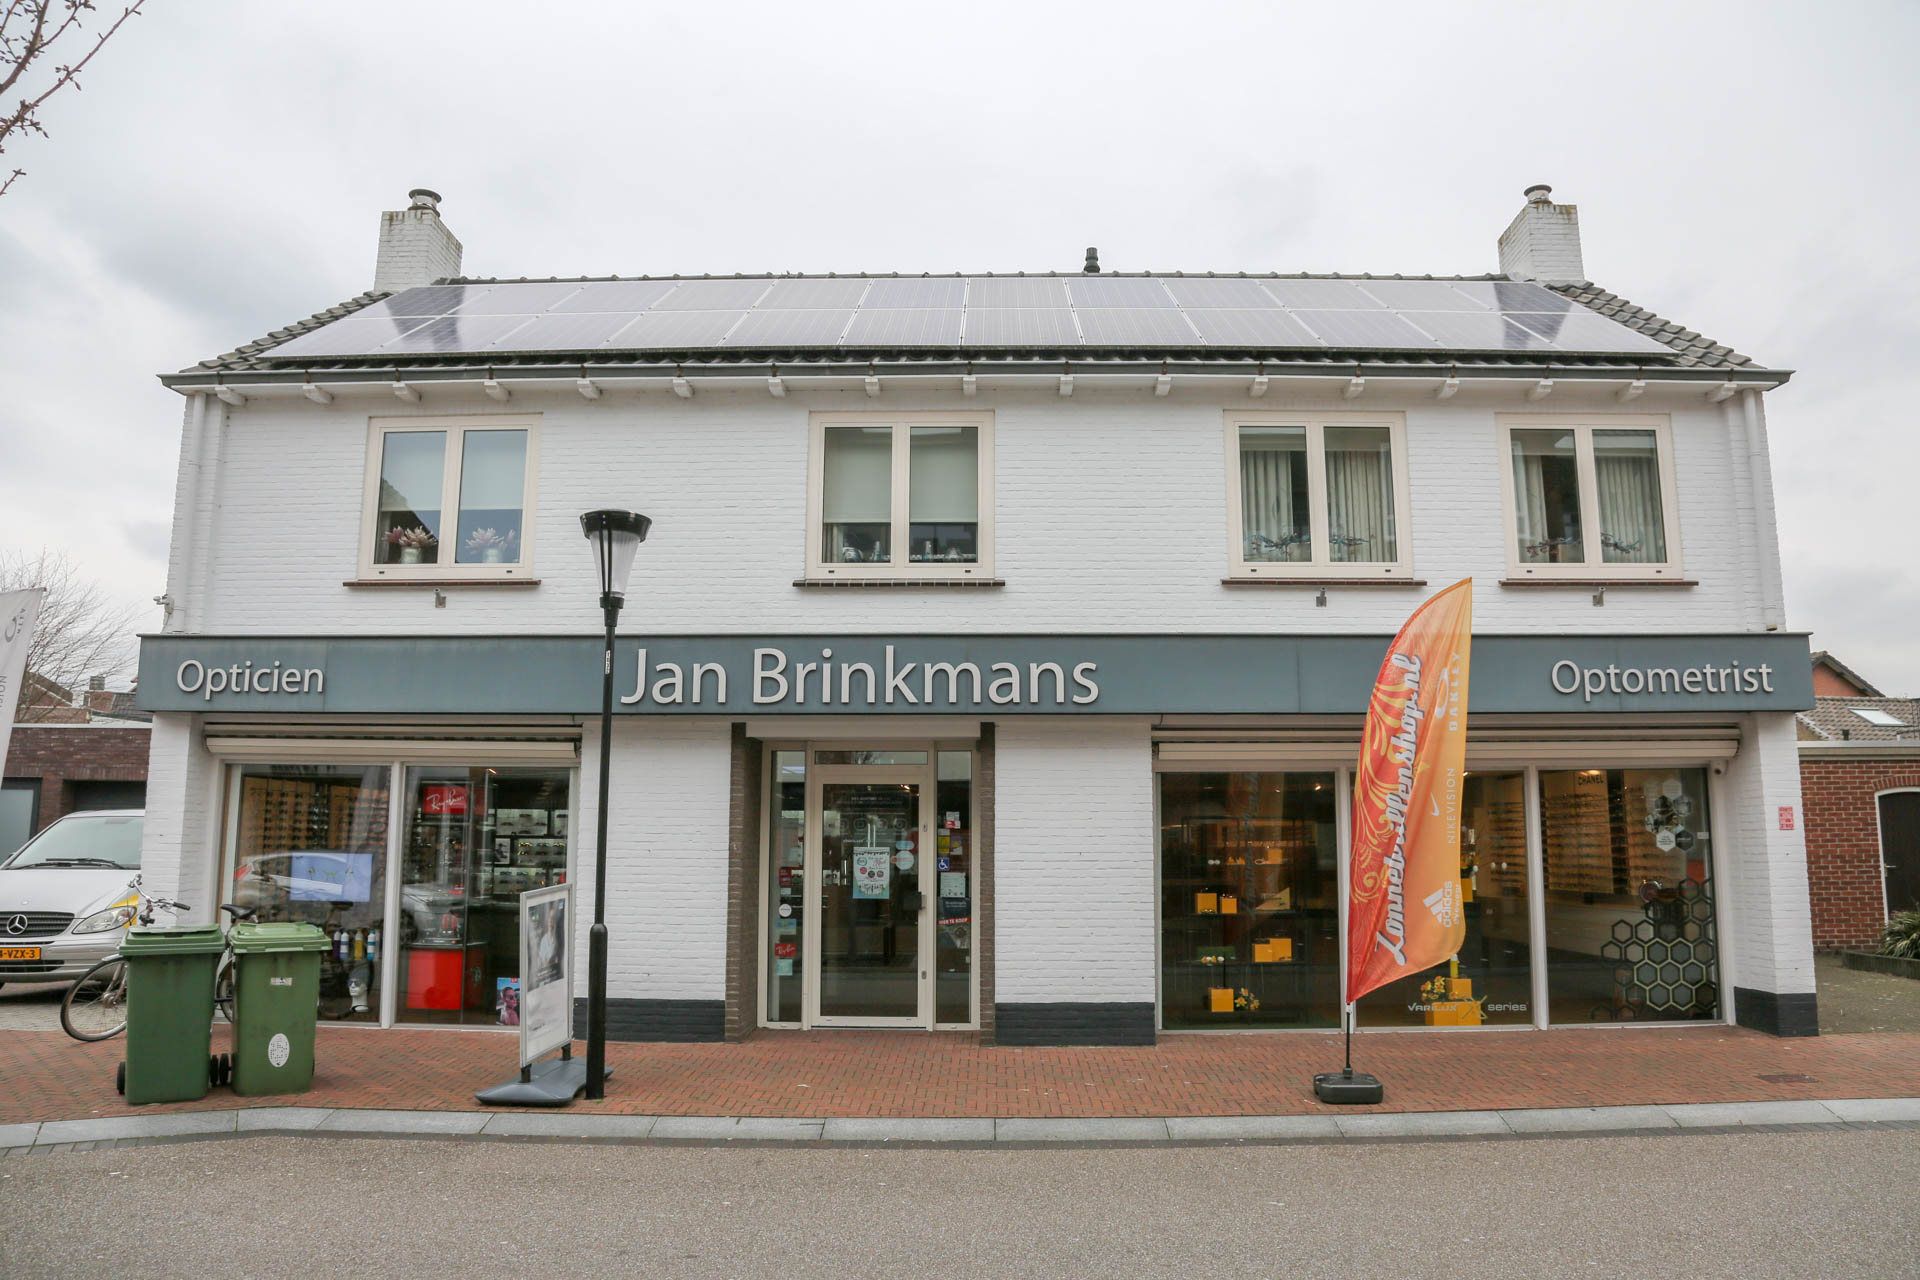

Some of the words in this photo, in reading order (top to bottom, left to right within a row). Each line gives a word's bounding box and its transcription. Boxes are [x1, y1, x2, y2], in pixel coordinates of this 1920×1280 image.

[176, 659, 325, 701] Opticien
[620, 648, 728, 704] Jan
[753, 645, 1100, 704] Brinkmans
[1449, 652, 1461, 732] OAKLEY
[1551, 659, 1774, 702] Optometrist
[1443, 880, 1453, 928] adidas
[1487, 1002, 1528, 1011] series
